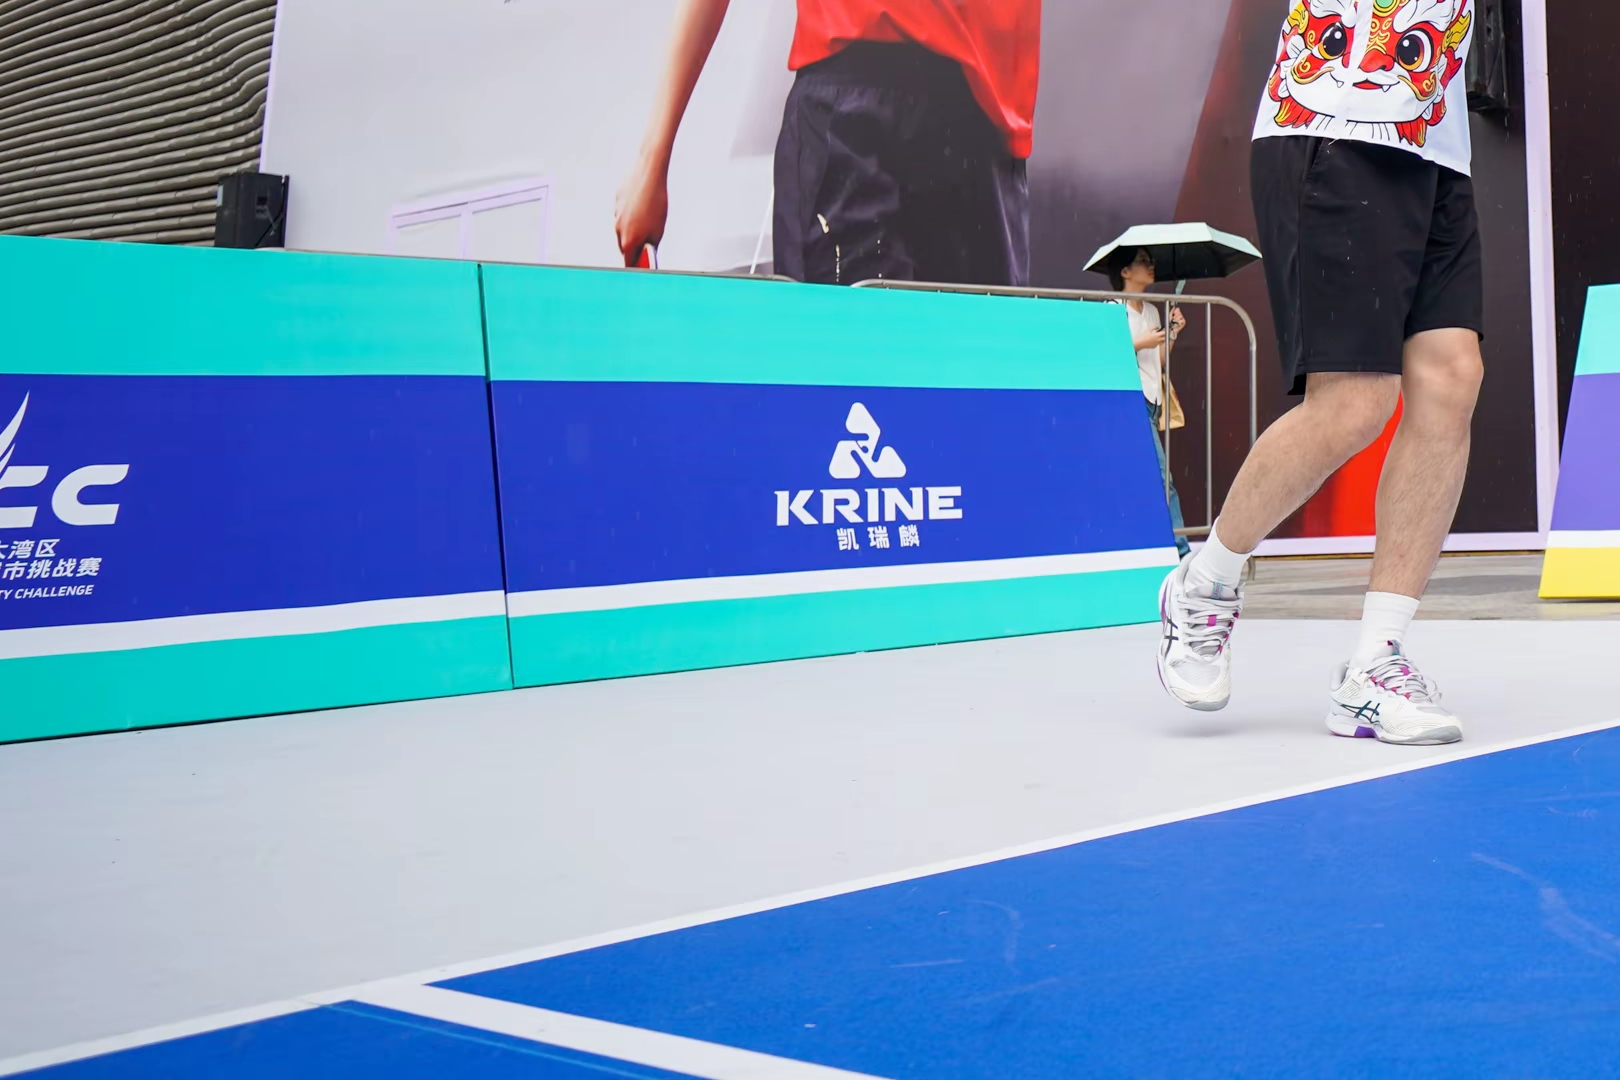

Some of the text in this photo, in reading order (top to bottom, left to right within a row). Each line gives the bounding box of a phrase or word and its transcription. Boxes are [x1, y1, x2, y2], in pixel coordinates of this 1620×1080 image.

[774, 486, 963, 526] KRINE
[836, 524, 920, 551] 凯瑞麟
[0, 557, 102, 580] 市挑战赛
[14, 584, 95, 599] CHALLENGE
